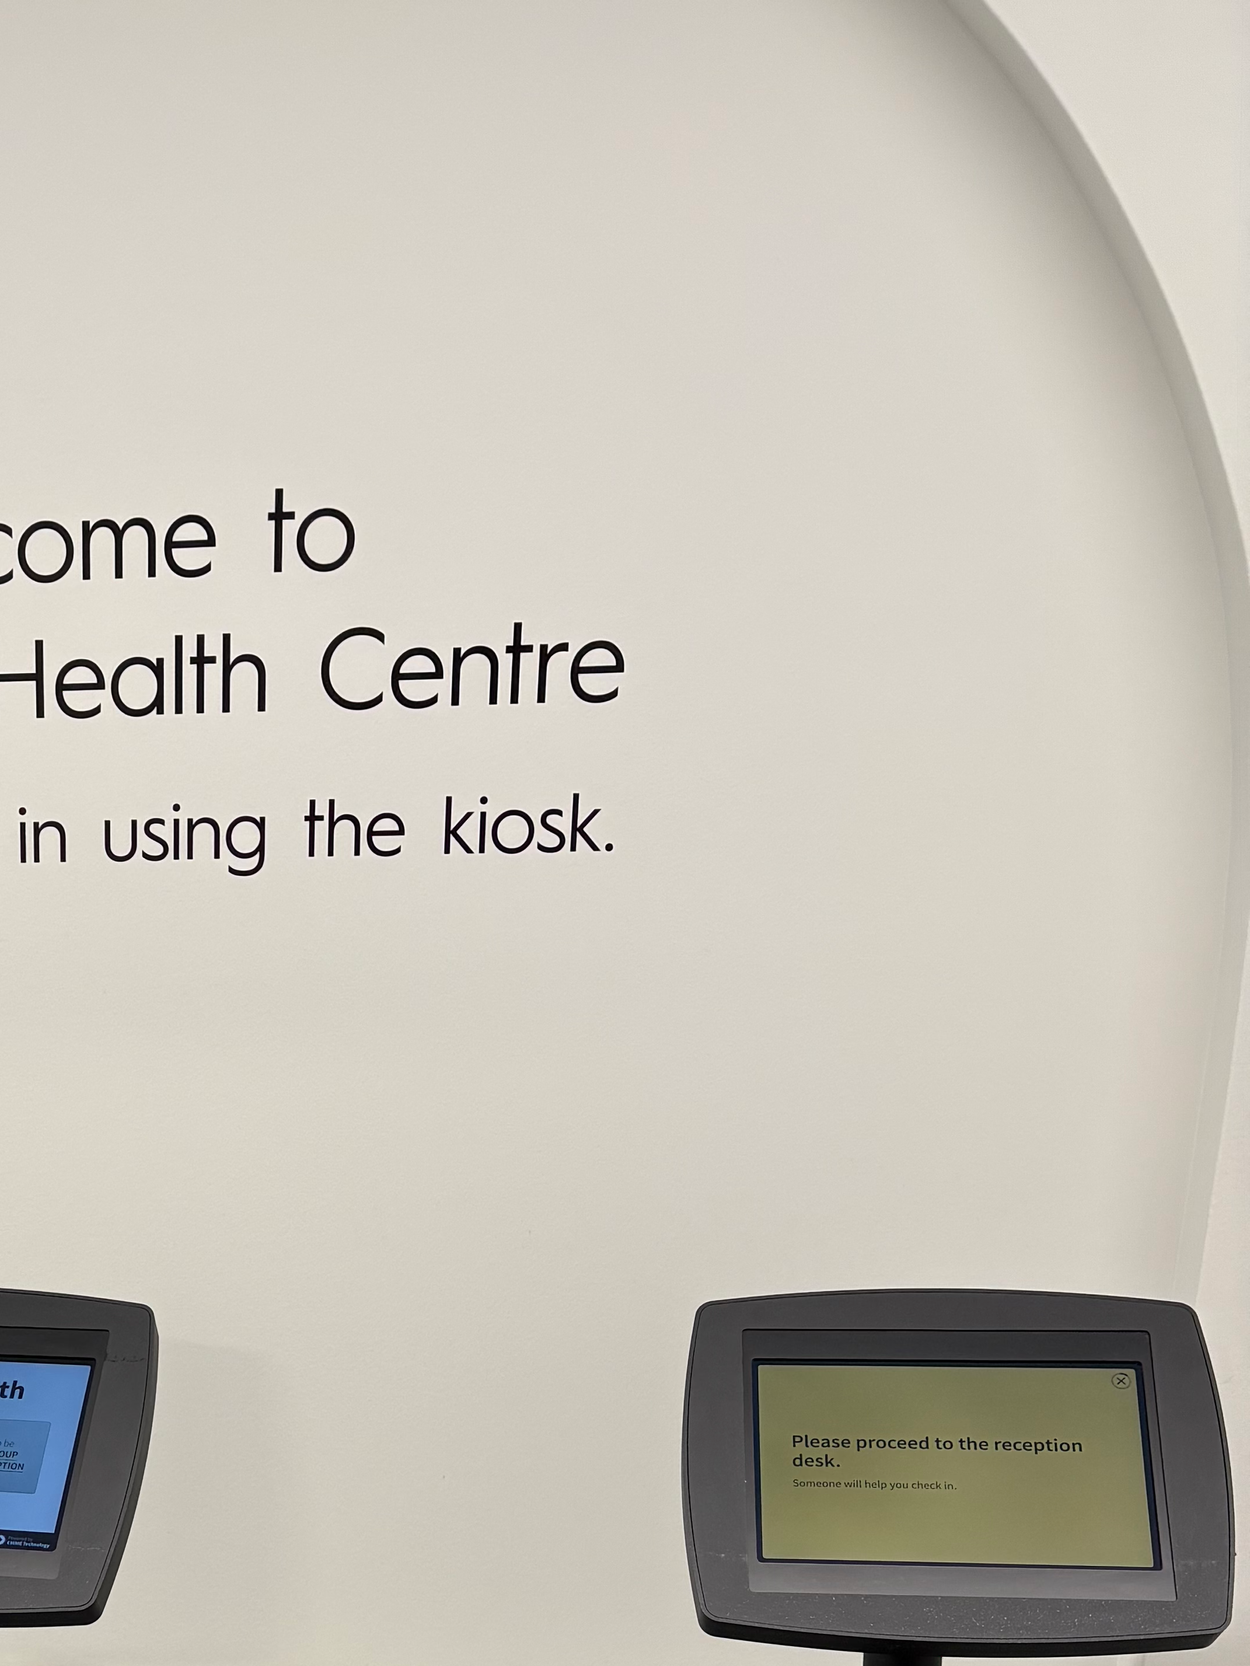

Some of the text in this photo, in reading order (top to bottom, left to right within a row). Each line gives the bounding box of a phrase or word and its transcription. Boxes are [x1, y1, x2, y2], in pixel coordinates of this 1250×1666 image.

[268, 488, 355, 572] to
[321, 622, 624, 710] Centre
[19, 807, 66, 863] in
[105, 804, 265, 876] using
[304, 799, 405, 857] the
[444, 793, 613, 854] kiosk.
[3, 1439, 14, 1447] be
[792, 1435, 1082, 1454] Please proceed to the reception
[792, 1454, 840, 1467] desk.
[793, 1479, 957, 1490] Someone will help you check in.
